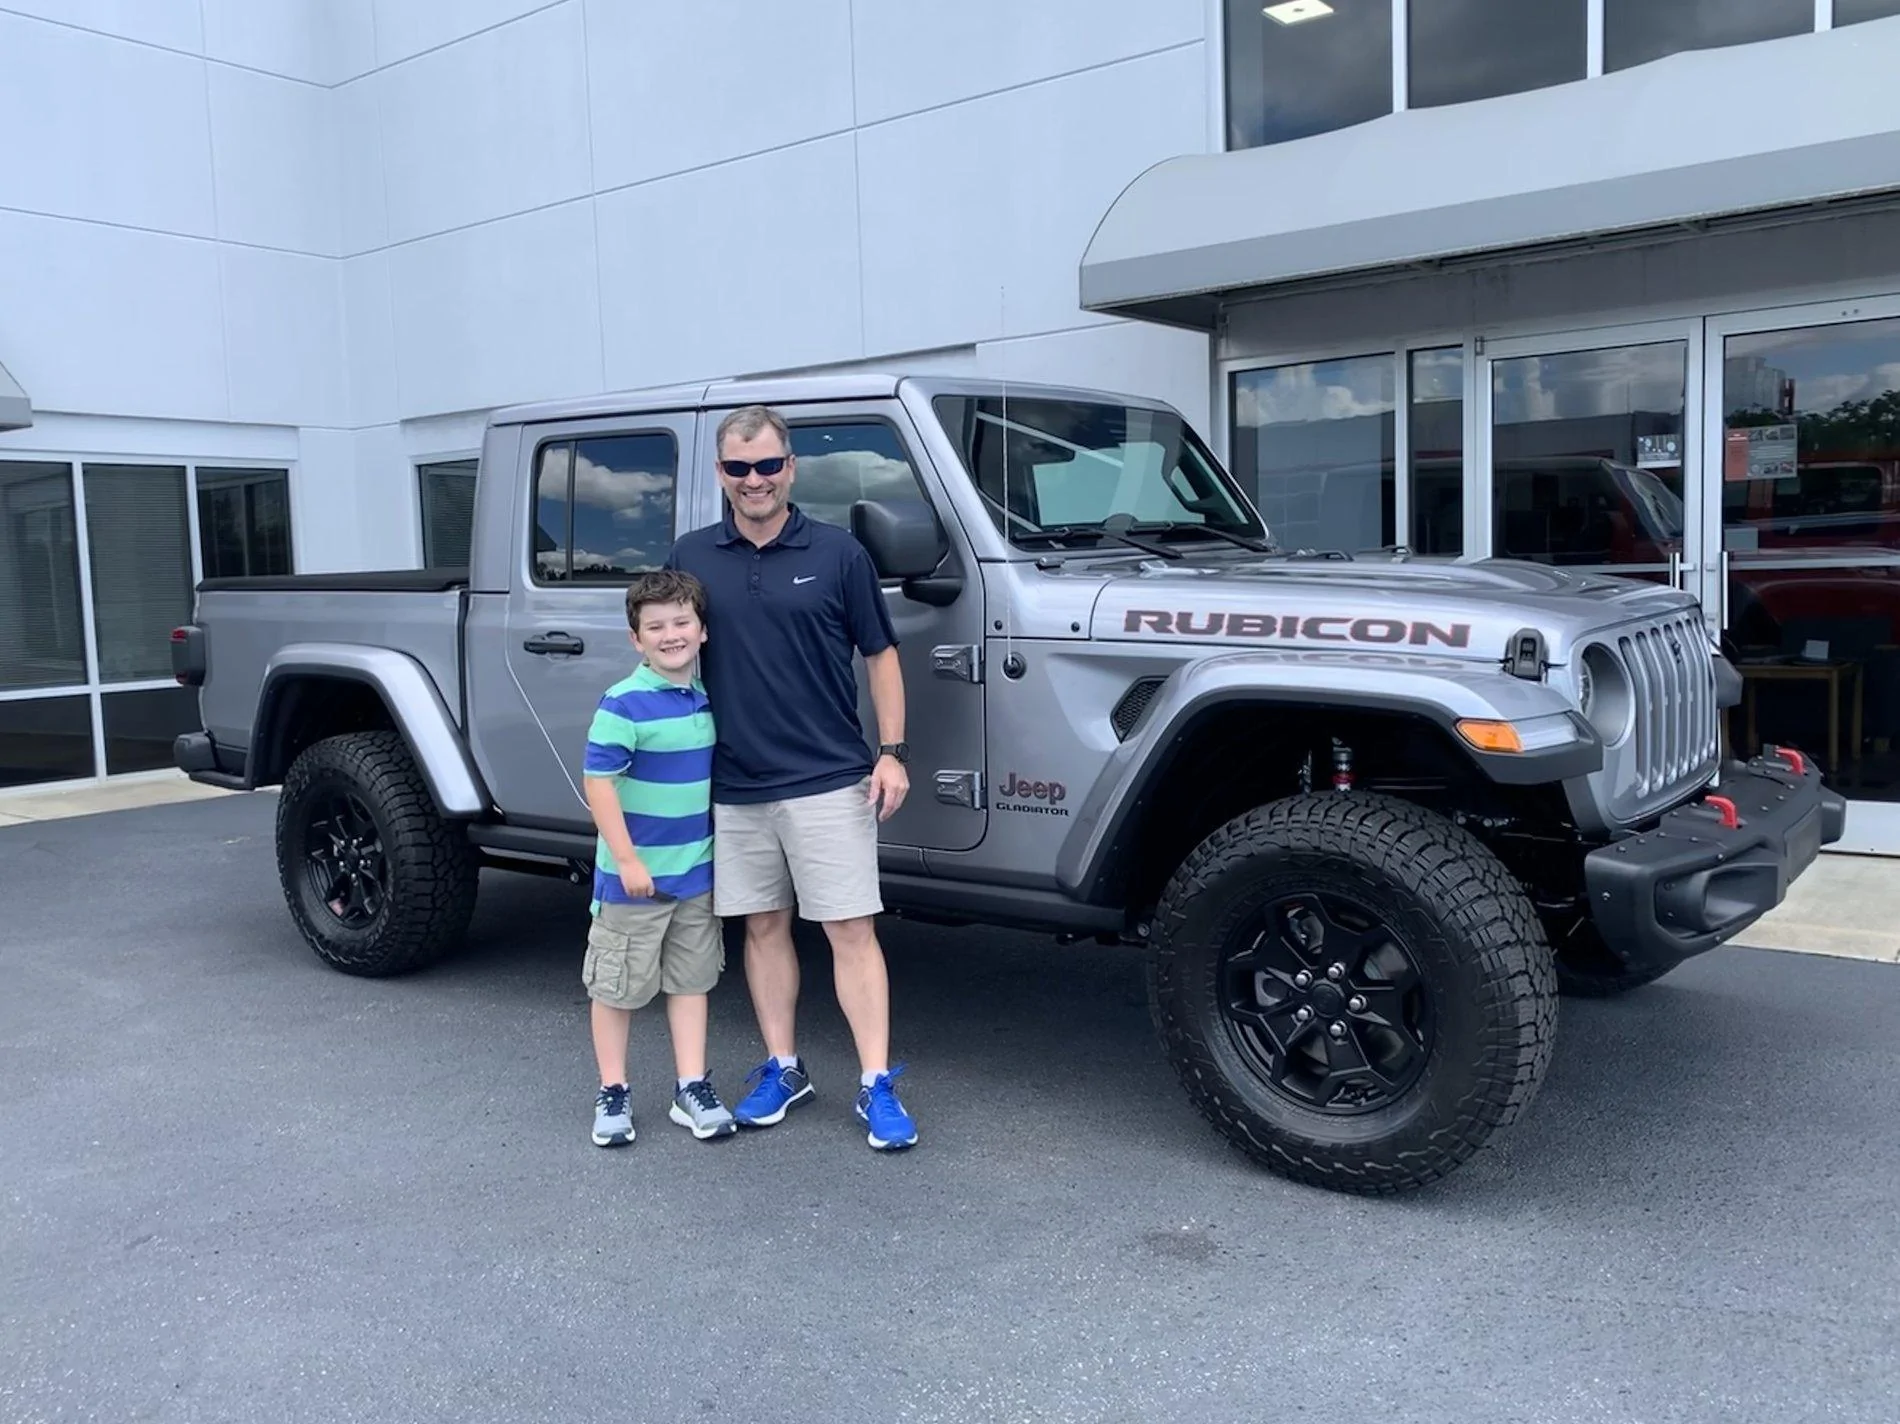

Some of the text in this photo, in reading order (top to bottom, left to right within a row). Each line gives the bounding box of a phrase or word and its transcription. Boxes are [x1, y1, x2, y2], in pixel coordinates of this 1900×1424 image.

[1122, 609, 1472, 649] RUBICON
[998, 771, 1067, 805] Jeep
[995, 801, 1070, 817] GLADIATOR
